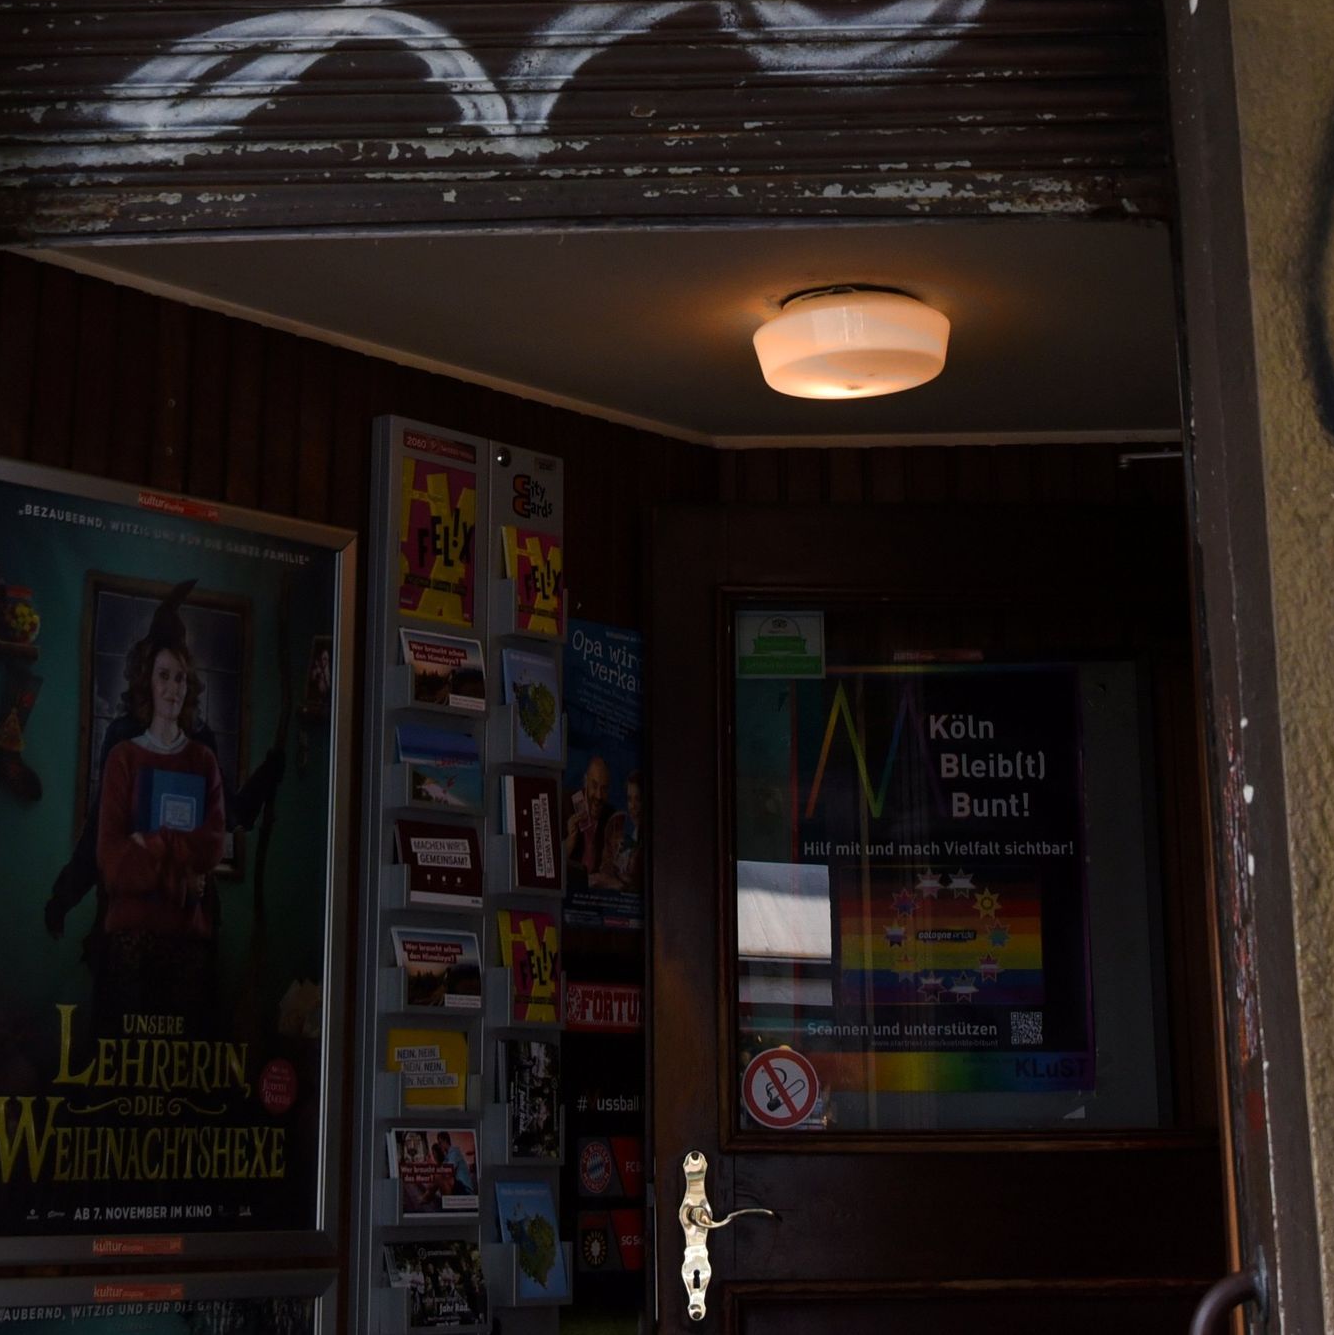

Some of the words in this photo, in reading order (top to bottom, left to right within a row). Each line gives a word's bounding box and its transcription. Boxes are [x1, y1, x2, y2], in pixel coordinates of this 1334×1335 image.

[512, 473, 546, 501] City
[512, 496, 553, 519] Cards
[572, 629, 603, 660] Opa
[928, 714, 995, 741] Köln
[939, 752, 1046, 780] Bleib(t)
[951, 791, 1030, 818] Bunt!
[803, 840, 832, 856] Hilf
[835, 840, 861, 856] mit
[864, 840, 895, 856] und
[898, 840, 941, 856] mach
[944, 840, 1001, 856] Vielfalt
[1003, 840, 1075, 856] sichtbar!
[122, 1014, 185, 1035] UNSERE
[807, 1021, 870, 1036] Scannen
[872, 1021, 900, 1036] und
[904, 1021, 998, 1036] unterstützen
[52, 1002, 252, 1098] LEHRERIN,
[134, 1096, 164, 1117] DIE
[73, 1207, 90, 1221] AB
[93, 1206, 103, 1221] 7.
[105, 1205, 168, 1220] NOVEMBER
[170, 1205, 183, 1218] IM
[185, 1204, 213, 1218] KINO
[118, 1304, 144, 1315] UND
